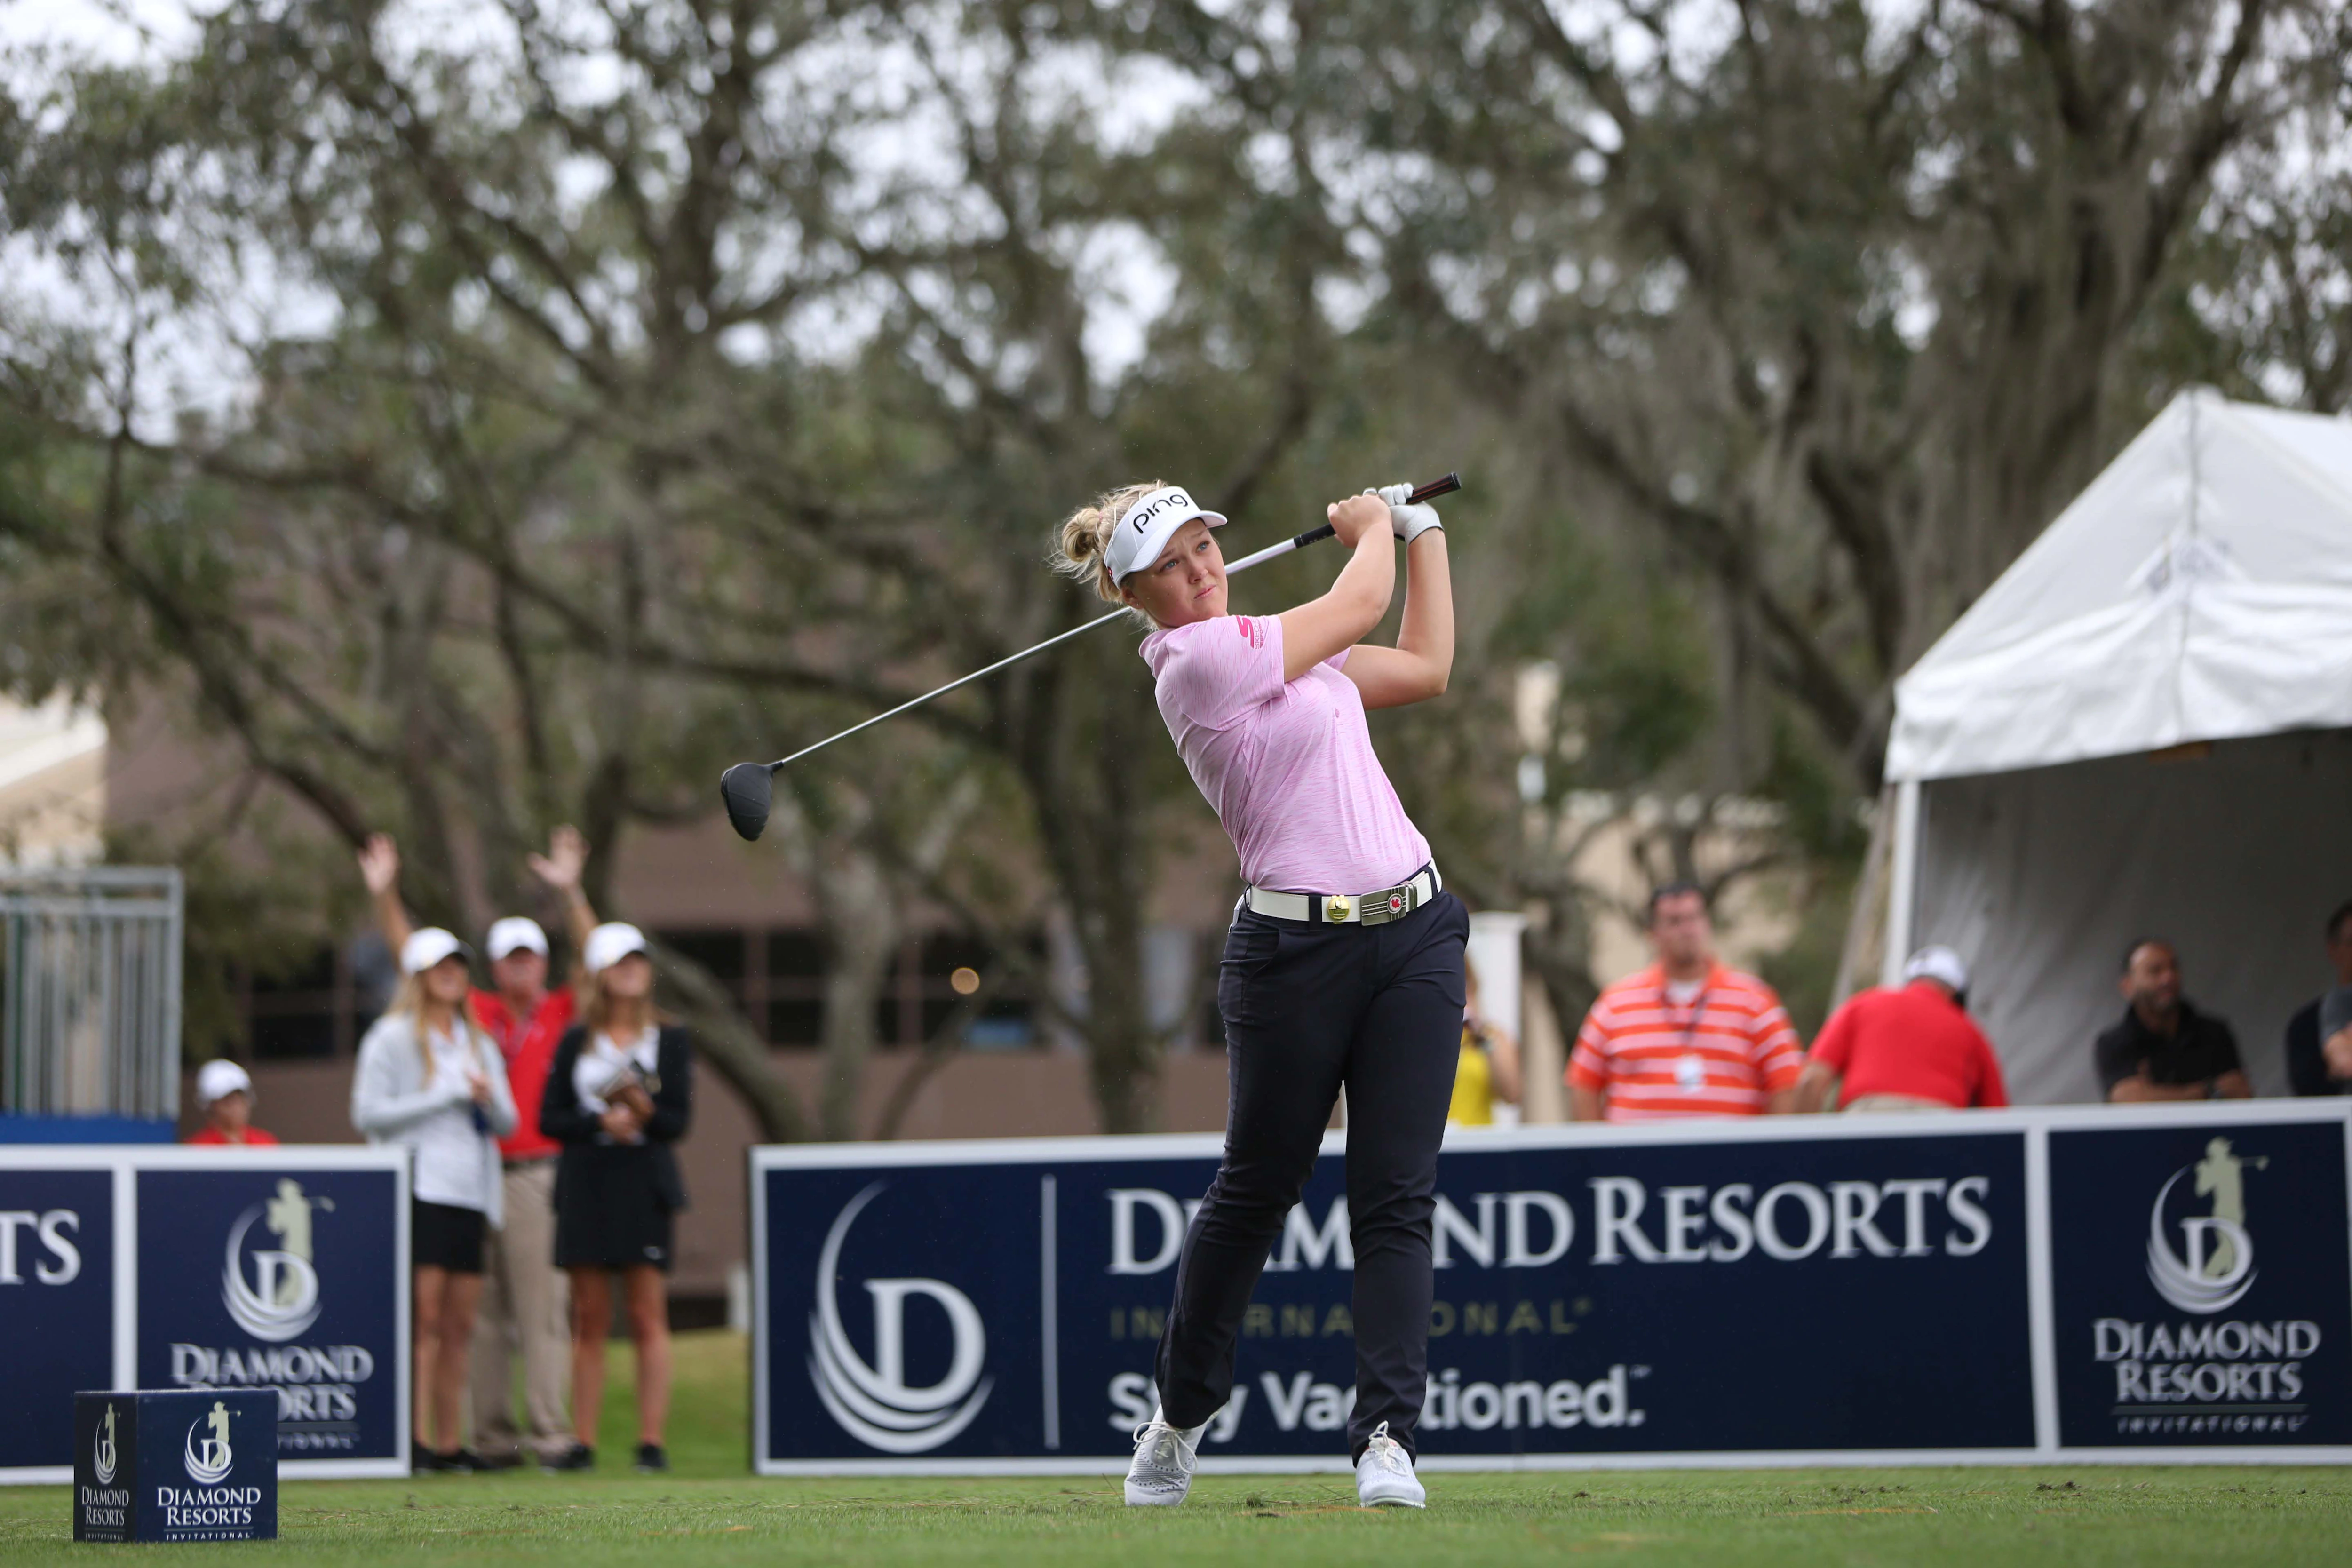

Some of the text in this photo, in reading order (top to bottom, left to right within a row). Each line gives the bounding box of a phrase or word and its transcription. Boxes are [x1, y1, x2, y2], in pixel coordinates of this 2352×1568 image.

[1133, 494, 1189, 535] ping
[1103, 1176, 1993, 1275] DMND RESORTS
[1110, 1300, 1578, 1339] INRNAONAL
[2090, 1318, 2322, 1361] DIAMOND
[170, 1343, 375, 1385] DIAMOND
[2115, 1360, 2303, 1402] RESORTS
[1107, 1364, 1646, 1443] Sy Vationed.
[82, 1486, 129, 1507] DIAMOND
[86, 1505, 125, 1527] RESORTS
[158, 1486, 262, 1506] DIAMOND
[167, 1506, 253, 1526] RESORTS
